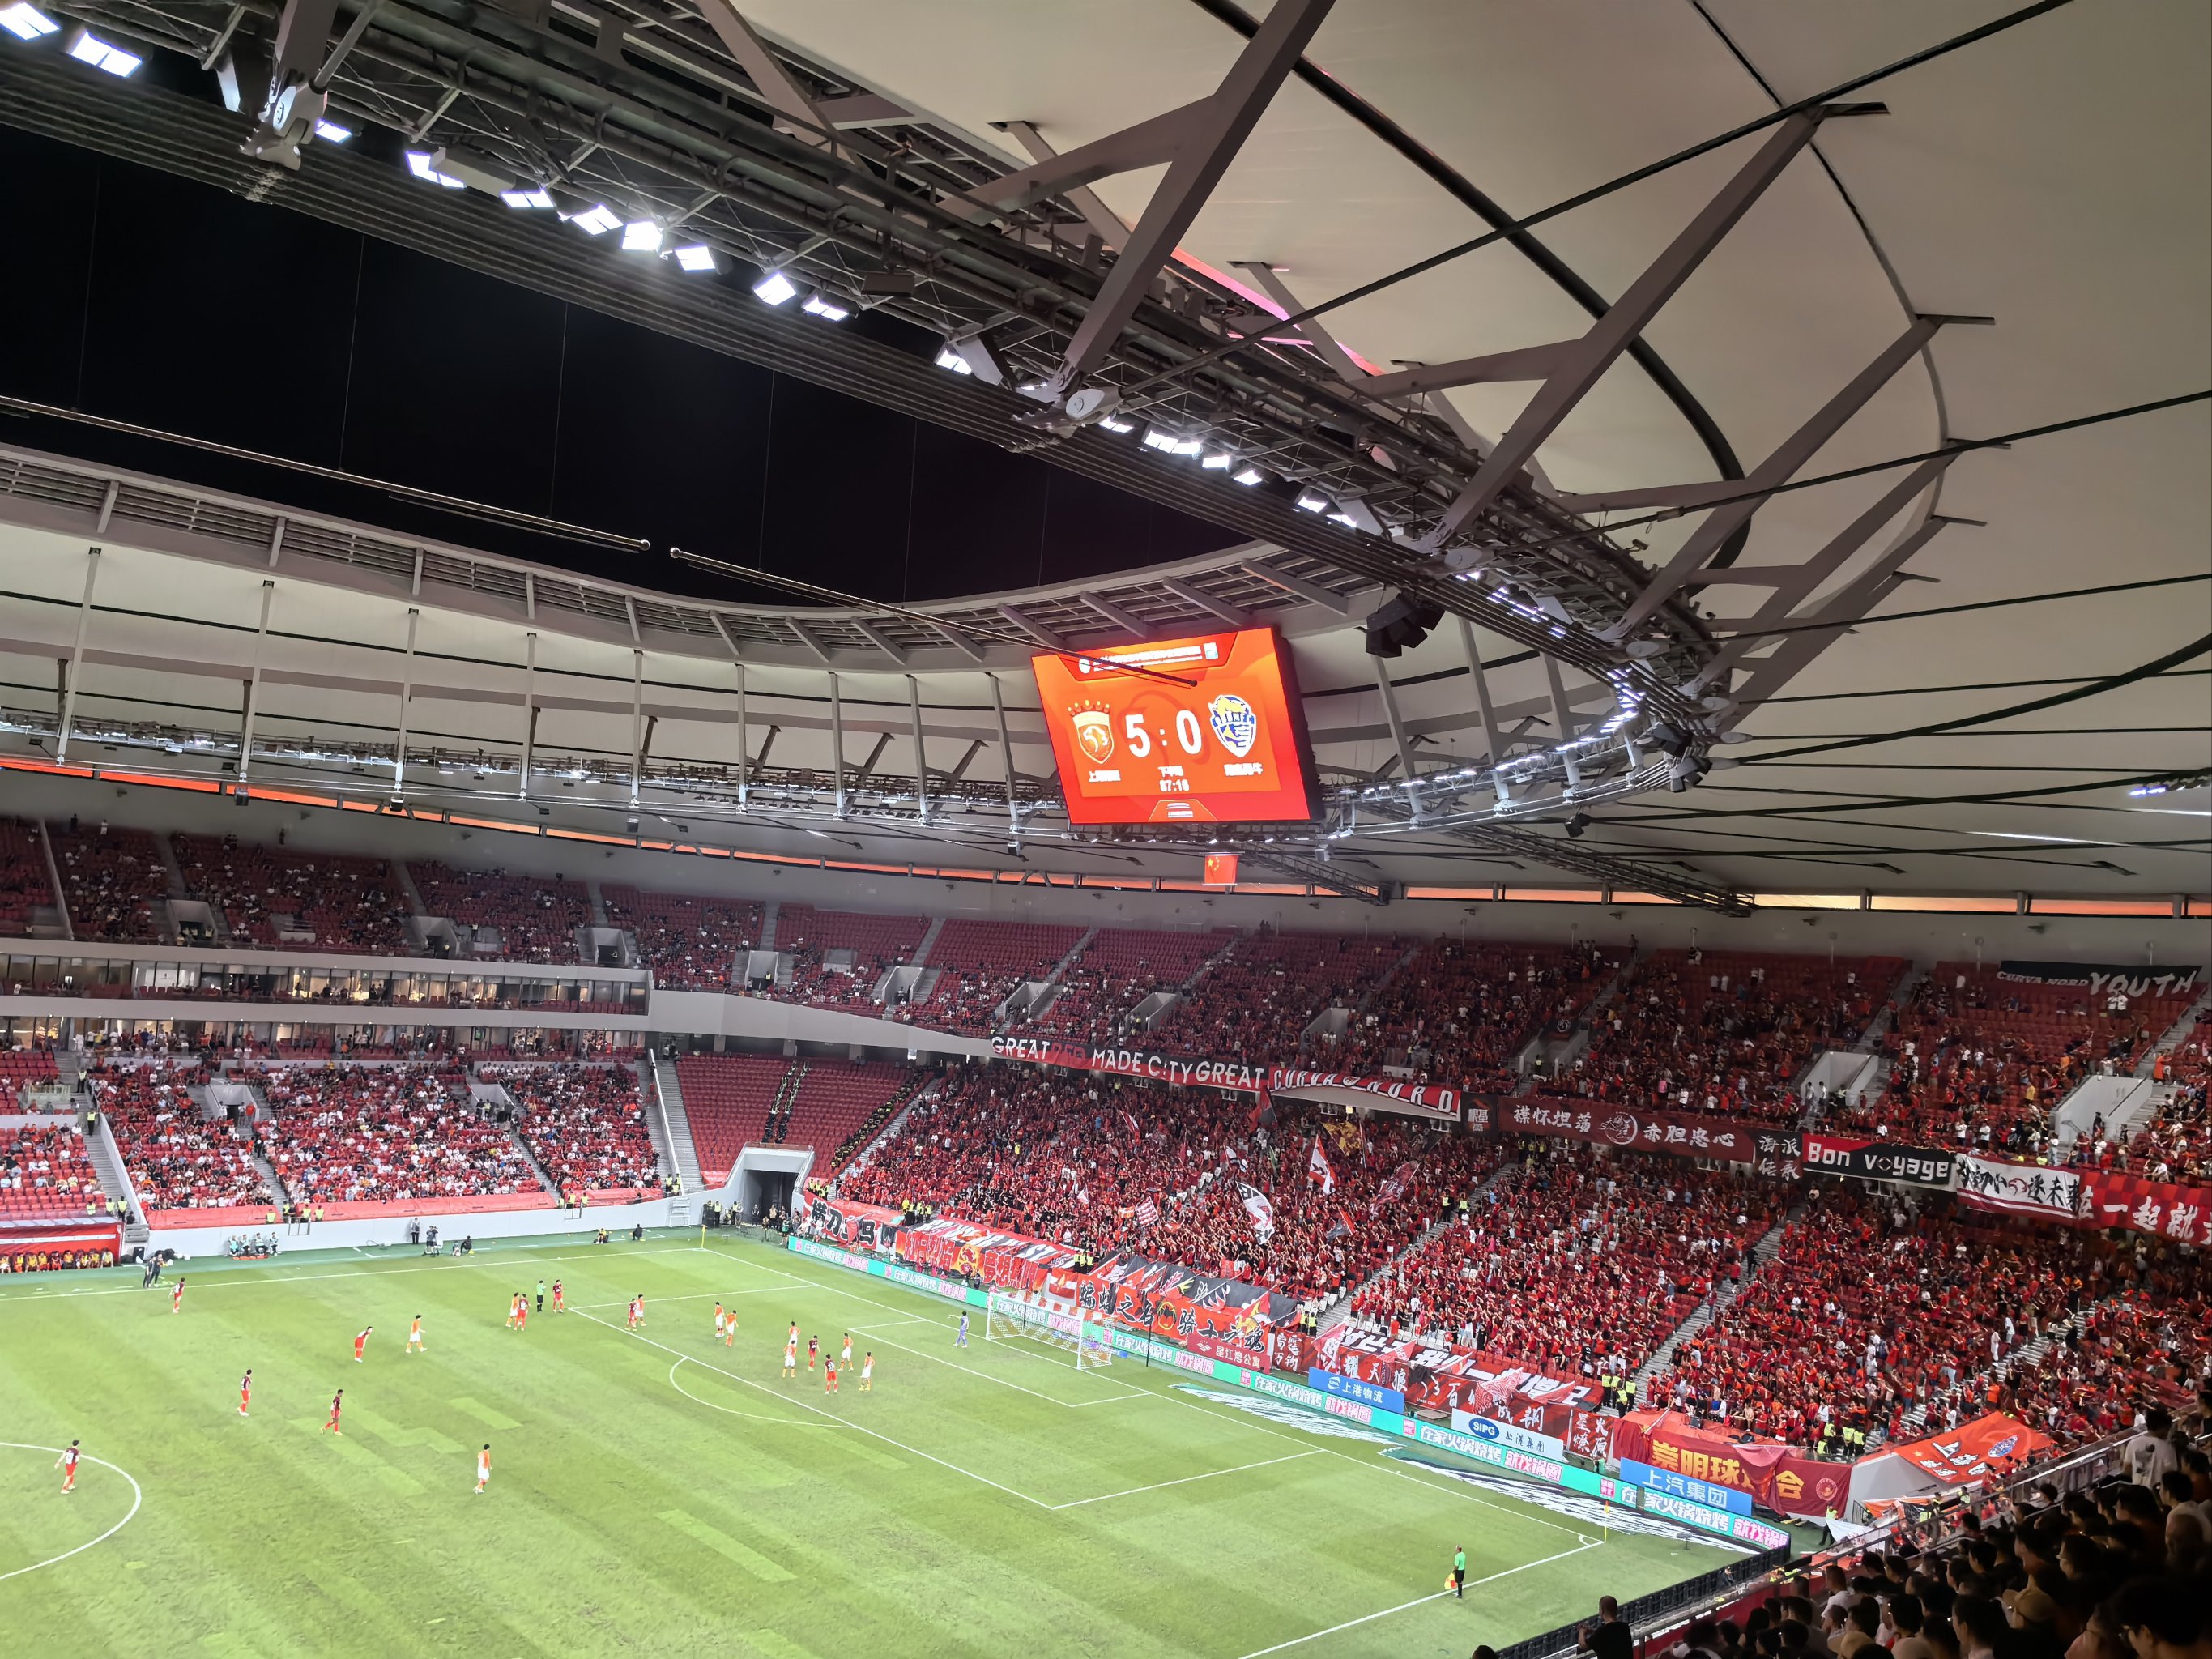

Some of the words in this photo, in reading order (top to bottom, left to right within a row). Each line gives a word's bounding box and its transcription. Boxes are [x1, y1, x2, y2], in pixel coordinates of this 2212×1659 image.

[2089, 970, 2197, 998] YOUTH
[991, 1036, 1051, 1060] GREAT
[1092, 1048, 1144, 1073] MADE
[1196, 1060, 1265, 1090] GREAT
[1274, 1069, 1337, 1090] CURVA
[1643, 1122, 1735, 1148] 赤胆忠心
[1758, 1135, 1801, 1157] 海派
[1758, 1157, 1801, 1180] 传承
[1807, 1141, 1851, 1167] Bon
[1864, 1154, 1950, 1181] voyage
[1255, 1375, 1323, 1408] 在家火锅烧烤
[1342, 1381, 1383, 1403] 上港物流
[1473, 1421, 1496, 1437] SIPG
[1574, 1413, 1609, 1436] 星火
[1420, 1424, 1502, 1464] 在家火锅烧烤
[1504, 1449, 1563, 1482] 就找锅圈
[1505, 1431, 1545, 1453] 上港集团
[1572, 1433, 1608, 1458] 燎原
[1642, 1469, 1728, 1508] 上汽集团
[1621, 1485, 1730, 1533] 在家火锅烧烤
